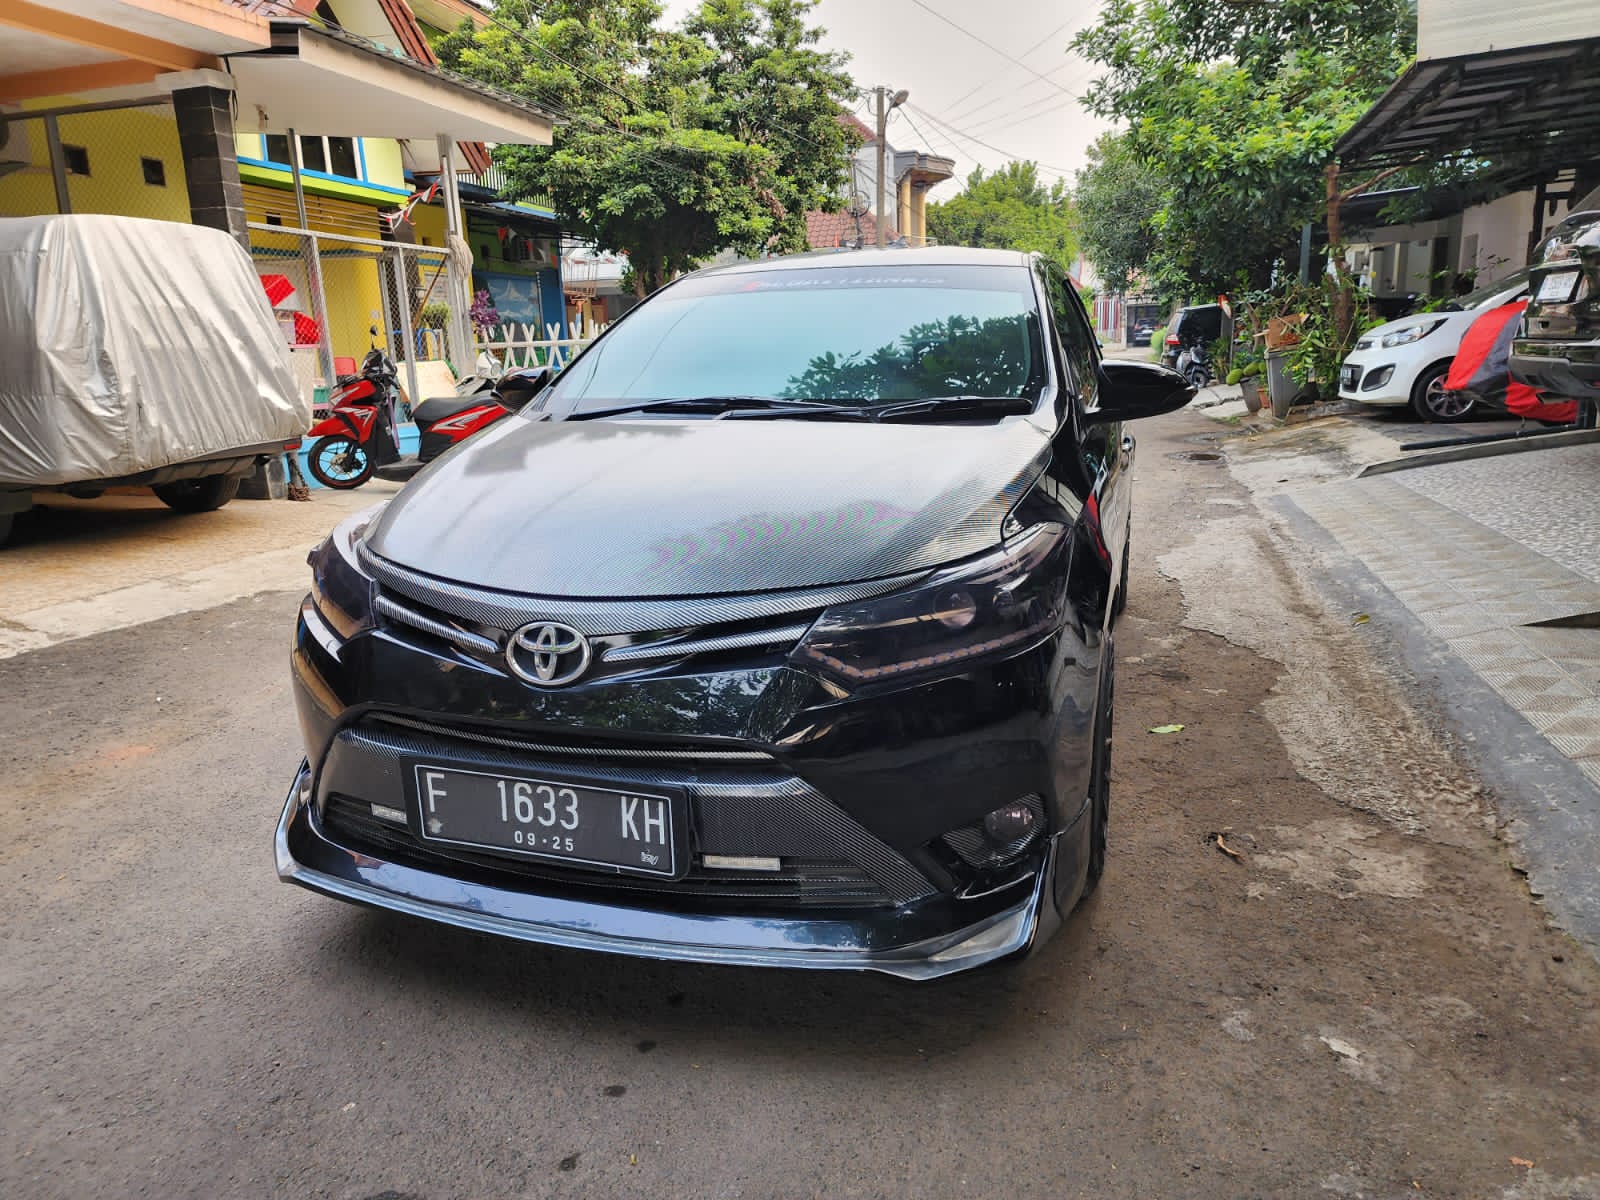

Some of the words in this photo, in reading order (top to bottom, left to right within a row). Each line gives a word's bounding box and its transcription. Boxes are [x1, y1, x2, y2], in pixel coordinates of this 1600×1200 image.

[425, 772, 447, 813] F
[496, 780, 579, 830] 1633
[620, 796, 666, 845] KH
